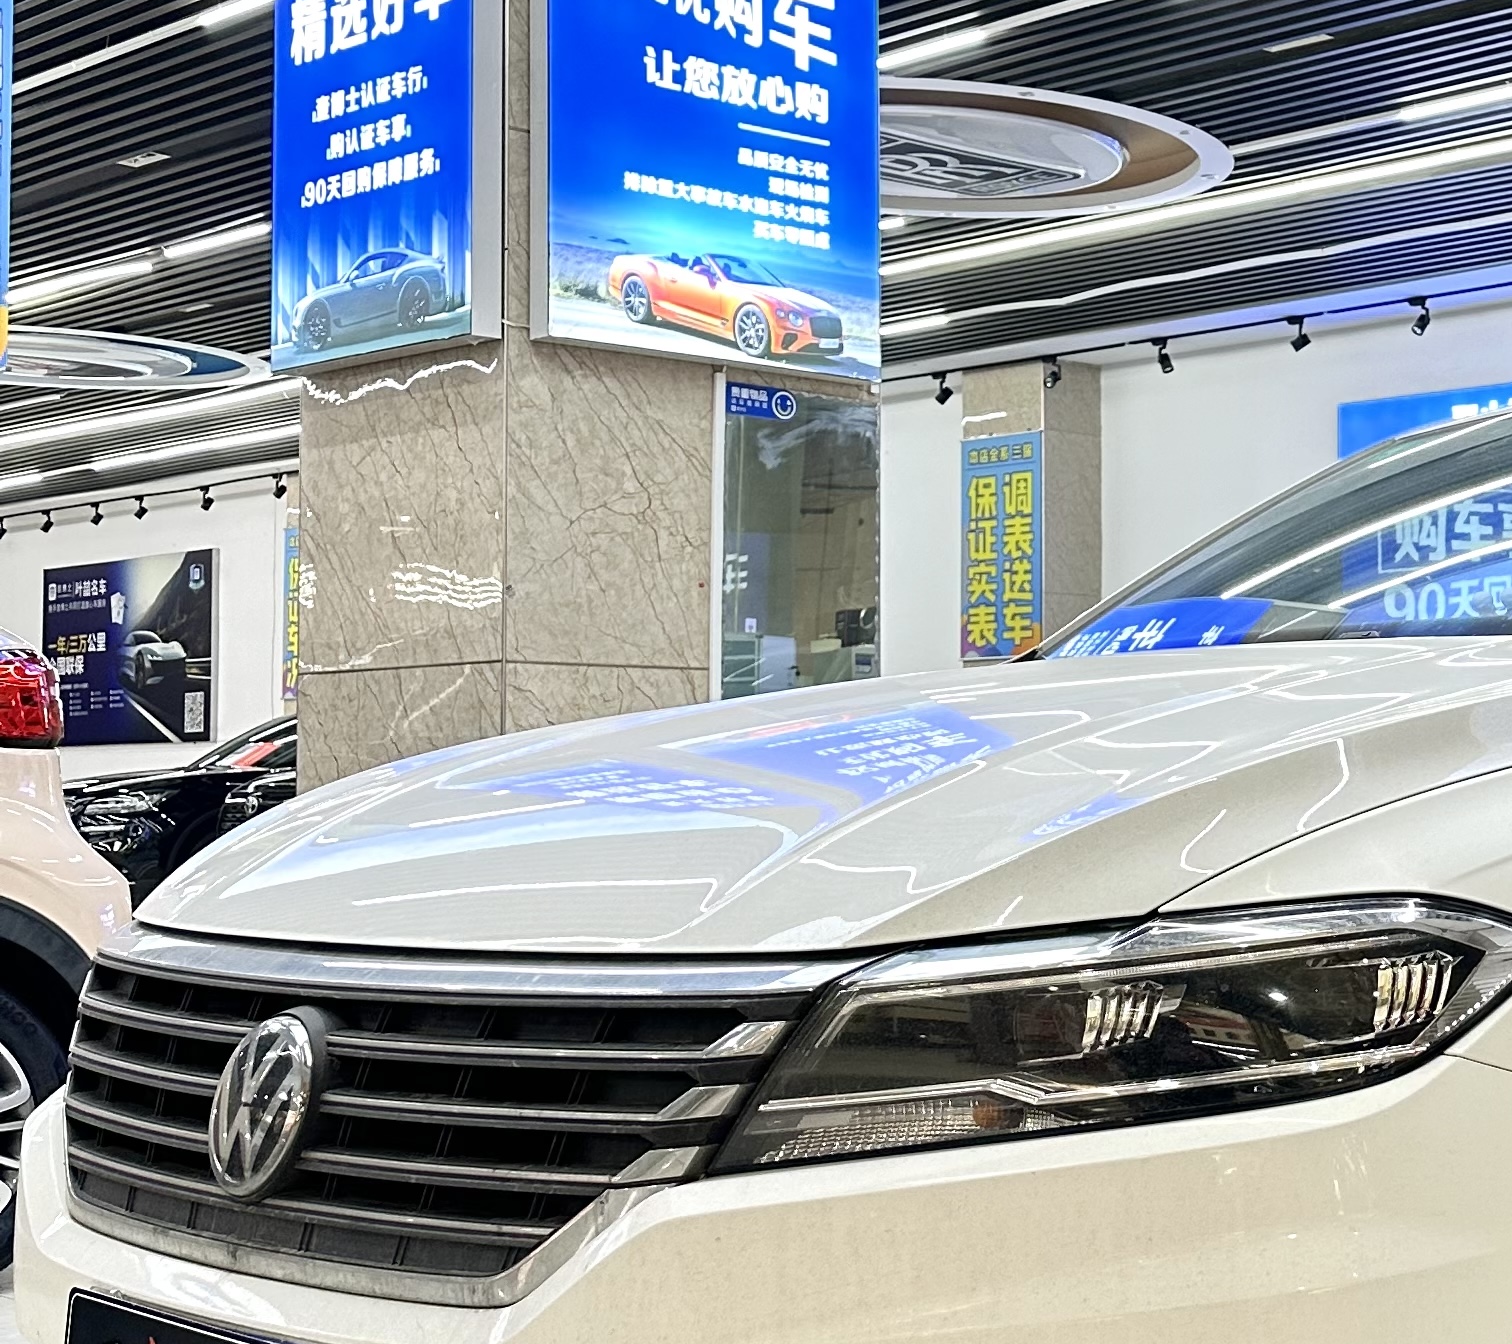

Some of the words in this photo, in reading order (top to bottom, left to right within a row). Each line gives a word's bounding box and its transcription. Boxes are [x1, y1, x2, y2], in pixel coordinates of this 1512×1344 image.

[642, 45, 829, 124] 让您放心购
[967, 474, 998, 647] 保证实表
[1002, 469, 1034, 646] 调表送车
[47, 631, 107, 655] 一年/三万公里
